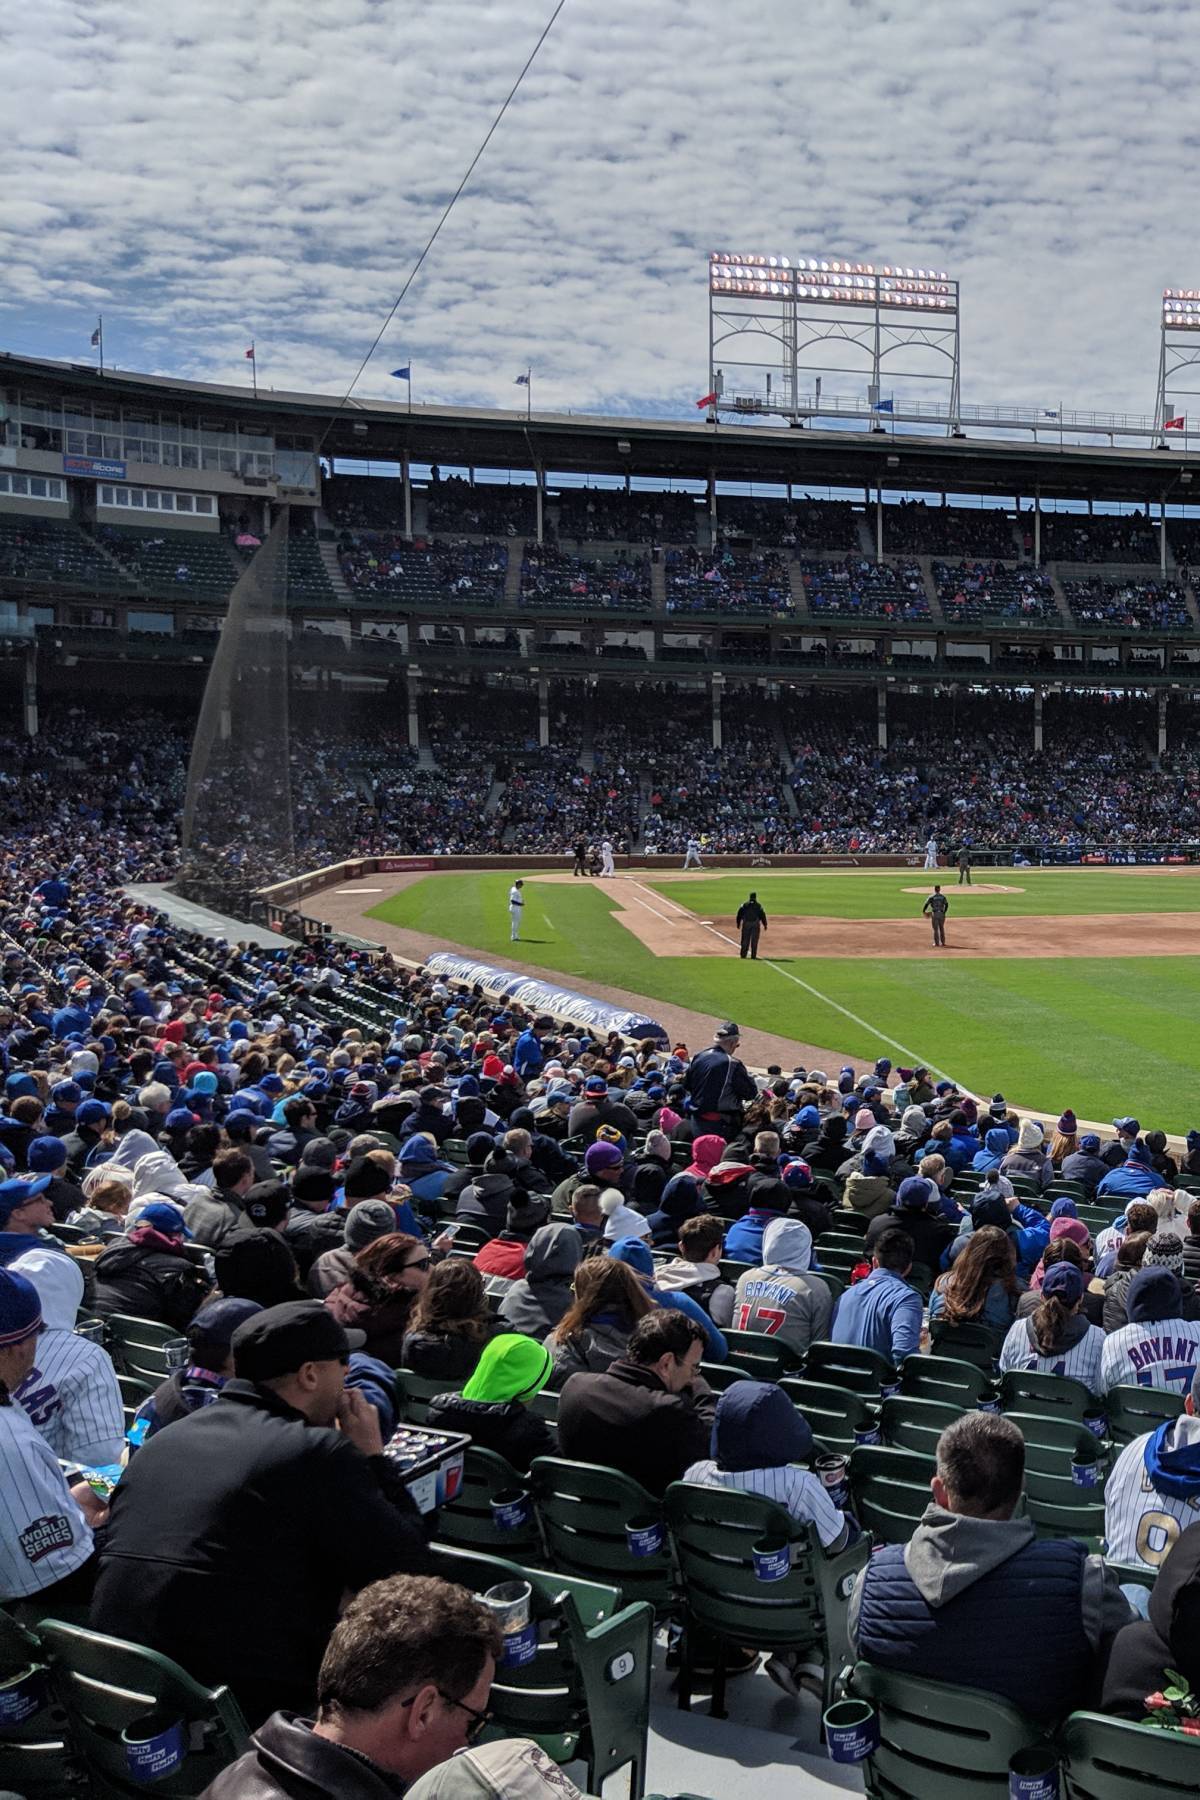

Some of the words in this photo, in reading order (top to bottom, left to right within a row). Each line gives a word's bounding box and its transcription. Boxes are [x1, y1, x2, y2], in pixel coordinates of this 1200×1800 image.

[745, 1280, 798, 1306] BRYANT
[738, 1303, 787, 1336] 17
[1128, 1336, 1199, 1371] BRYANT
[21, 1520, 68, 1545] WORLD
[25, 1528, 73, 1558] SERIES
[848, 1579, 854, 1591] 8
[619, 1658, 627, 1673] 9
